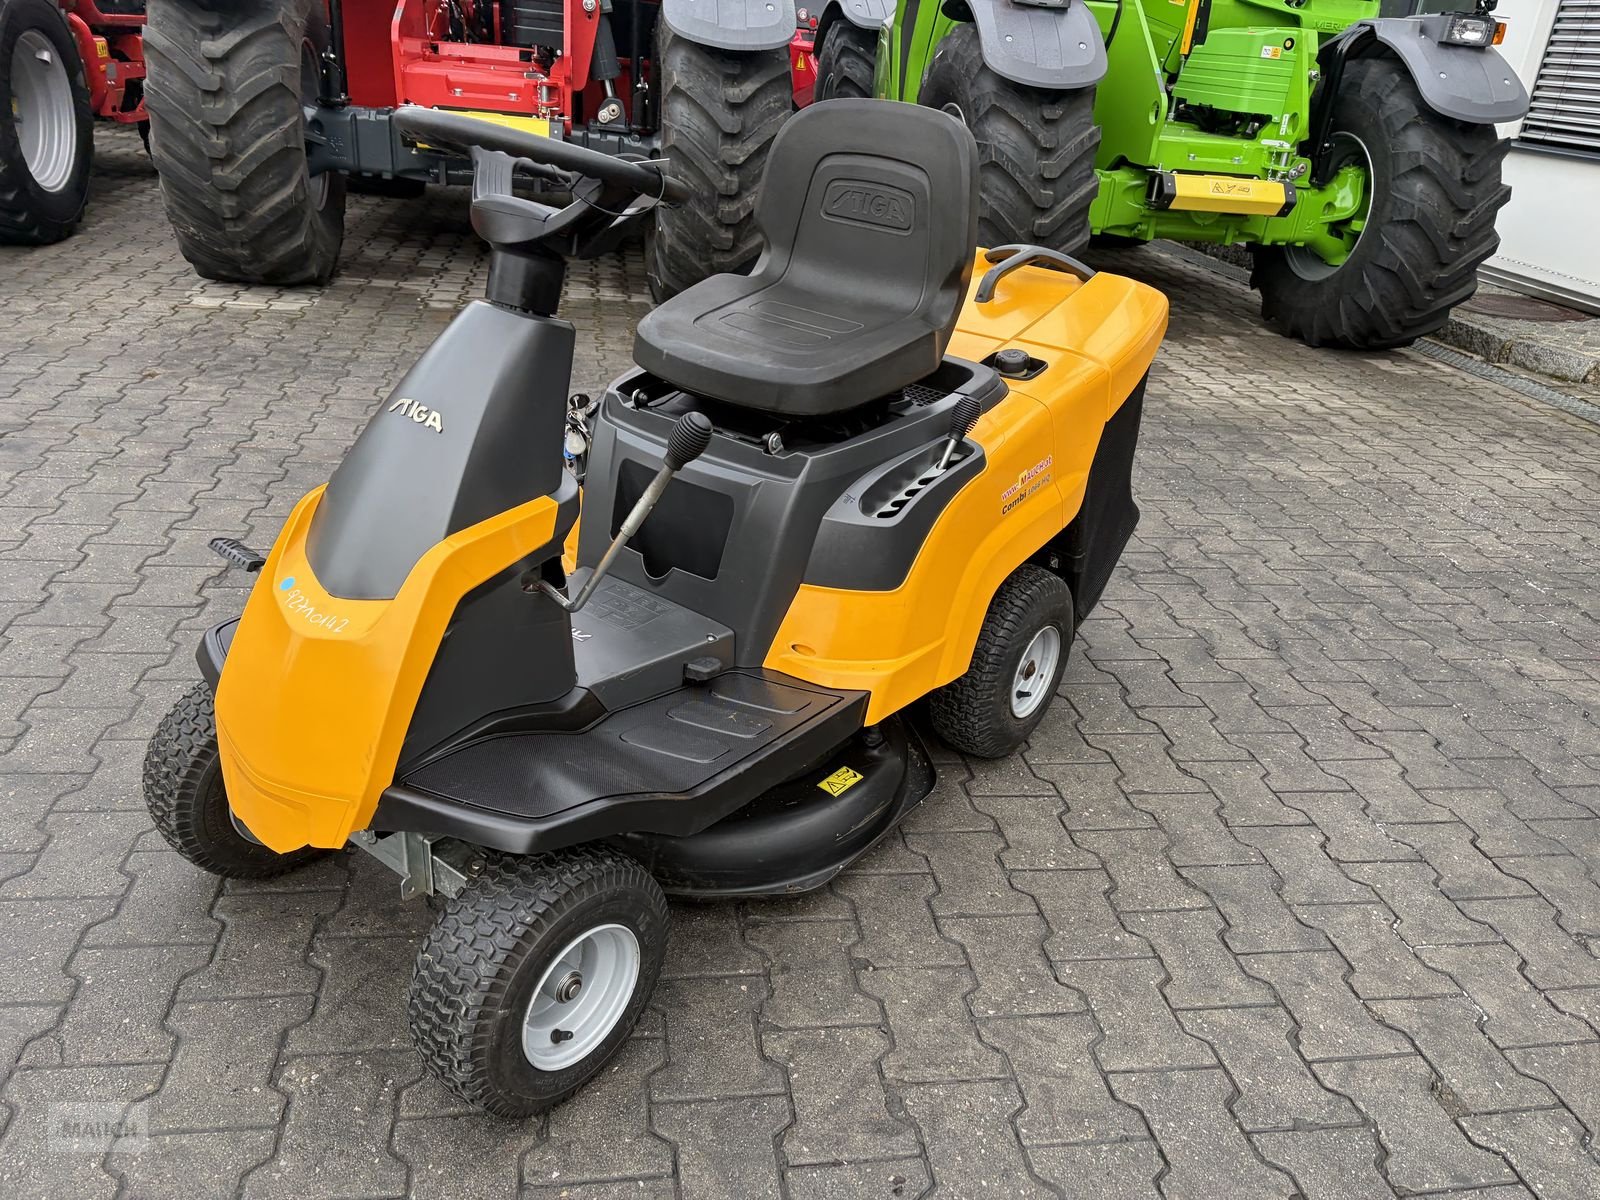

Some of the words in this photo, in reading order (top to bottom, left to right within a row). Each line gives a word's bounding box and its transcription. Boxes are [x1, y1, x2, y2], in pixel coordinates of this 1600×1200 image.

[832, 190, 905, 222] STIGA
[388, 398, 443, 433] STIGA
[1002, 489, 1027, 515] Combi
